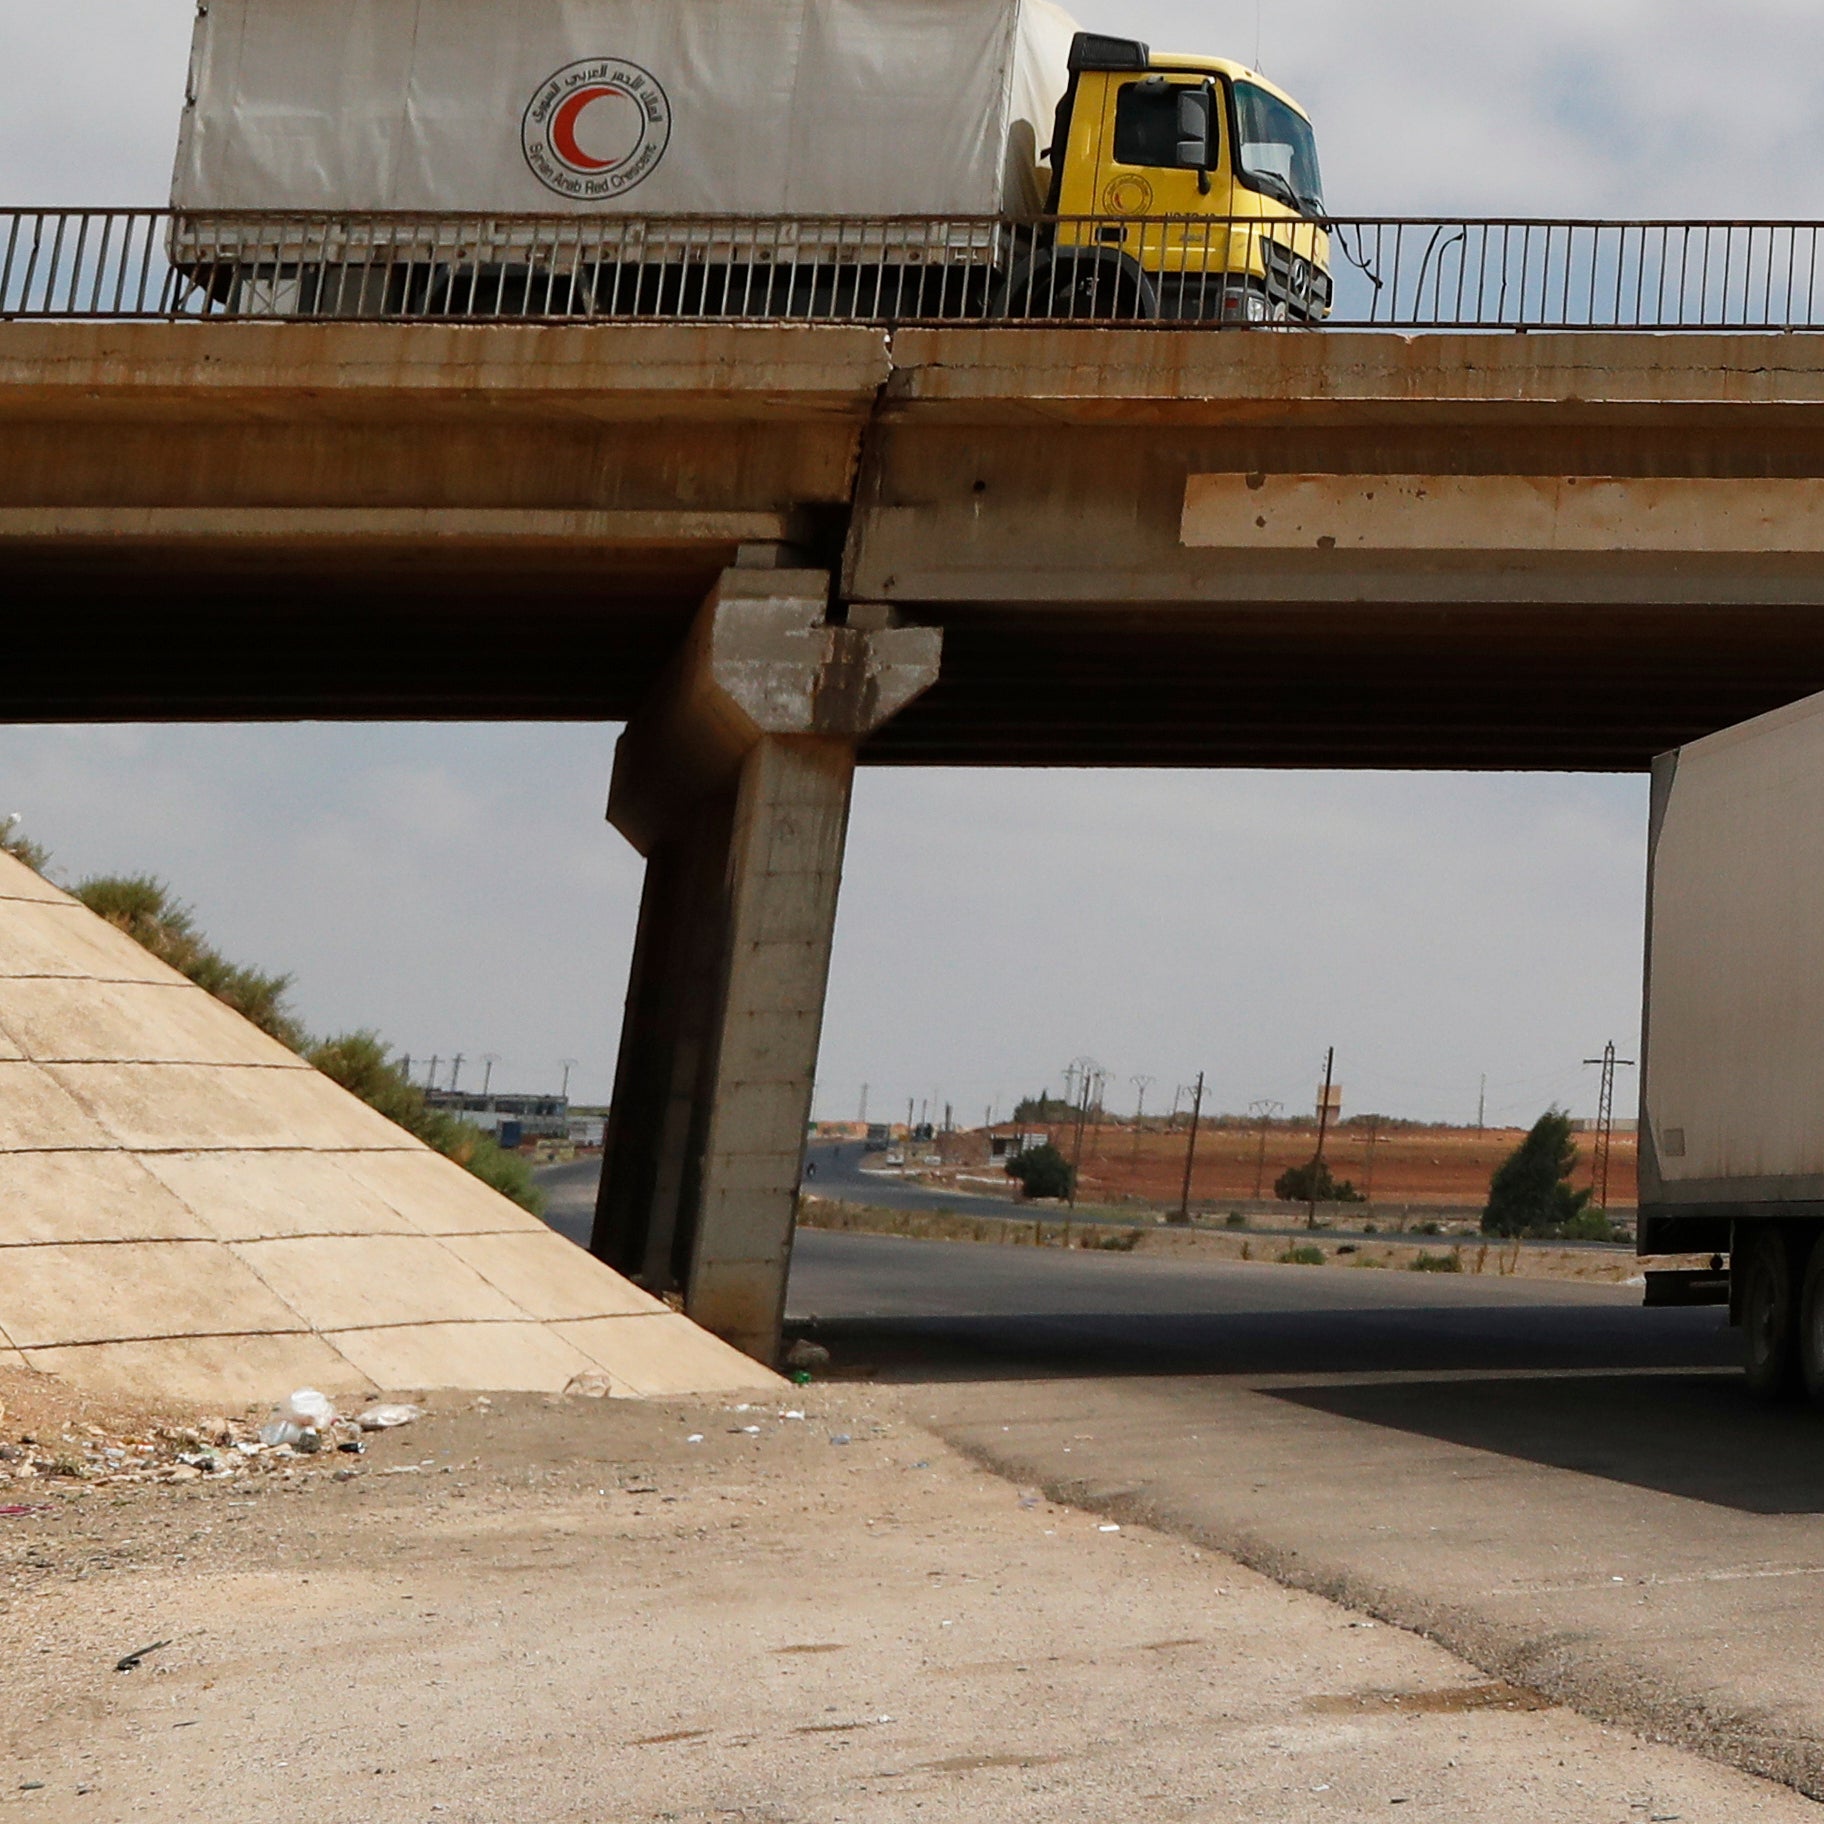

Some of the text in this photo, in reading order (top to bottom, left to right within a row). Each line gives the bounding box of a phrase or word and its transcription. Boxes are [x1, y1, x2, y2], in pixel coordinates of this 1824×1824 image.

[529, 142, 657, 194] Syrian Arab Red Crescent
